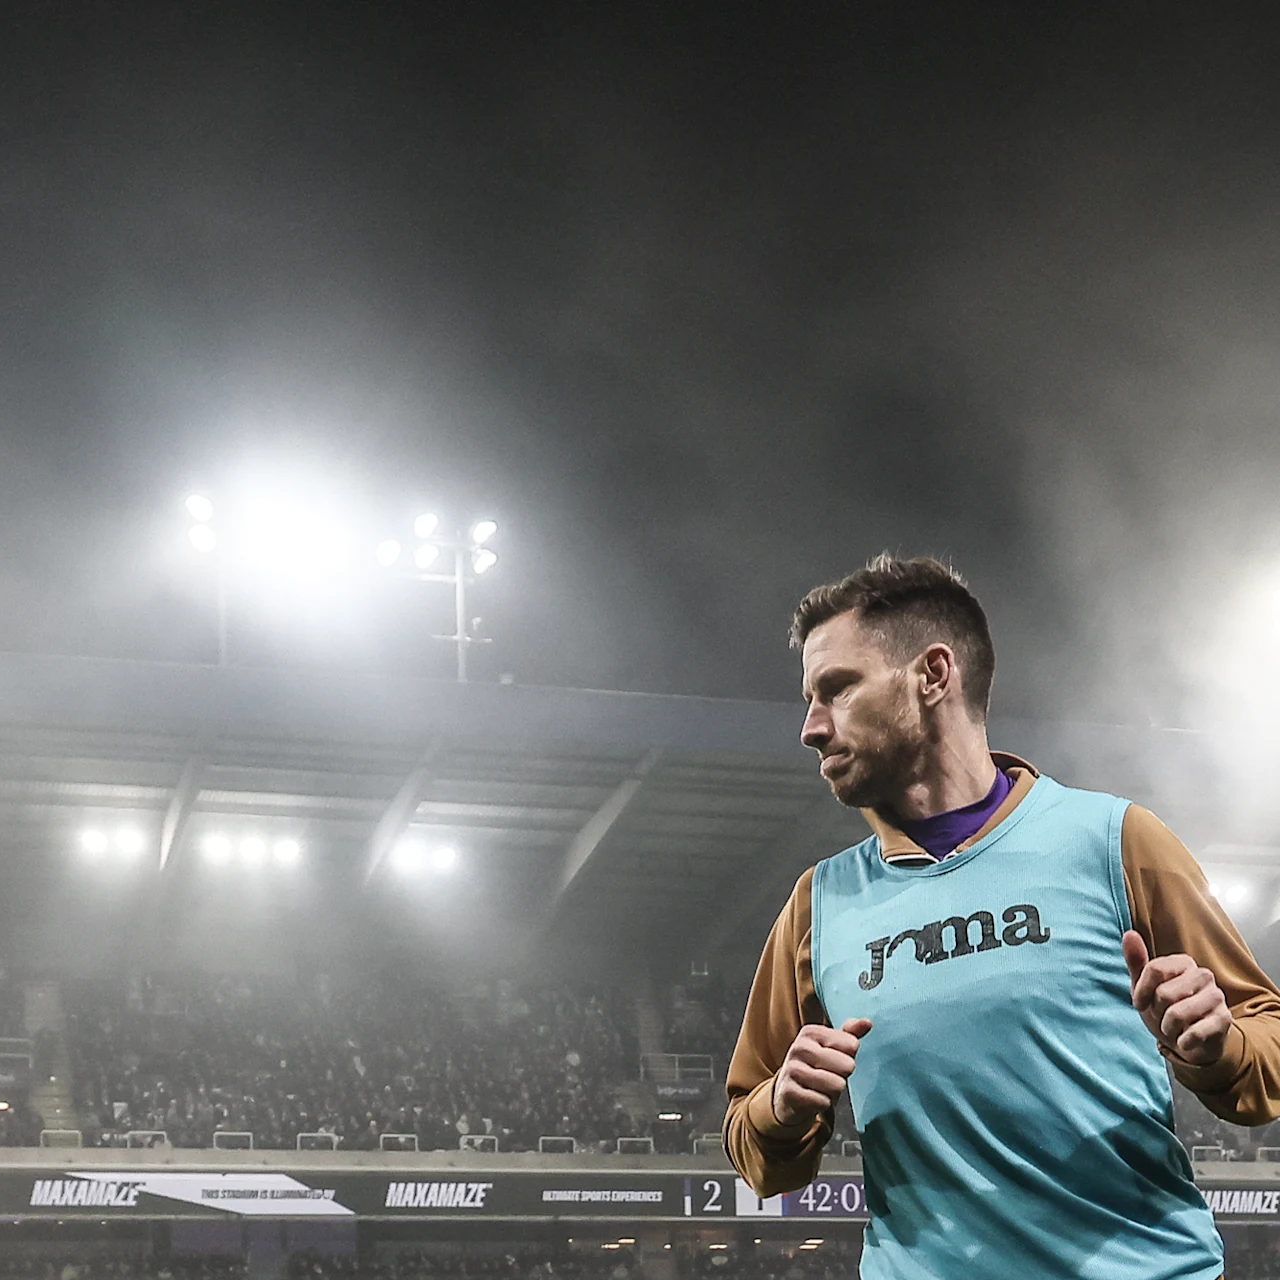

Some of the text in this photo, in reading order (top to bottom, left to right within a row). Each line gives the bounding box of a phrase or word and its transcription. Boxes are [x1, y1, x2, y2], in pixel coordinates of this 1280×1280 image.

[858, 904, 1050, 990] joma
[29, 1180, 142, 1206] MAXAMAZE
[385, 1182, 492, 1207] MAXAMAZE
[703, 1181, 722, 1211] 2
